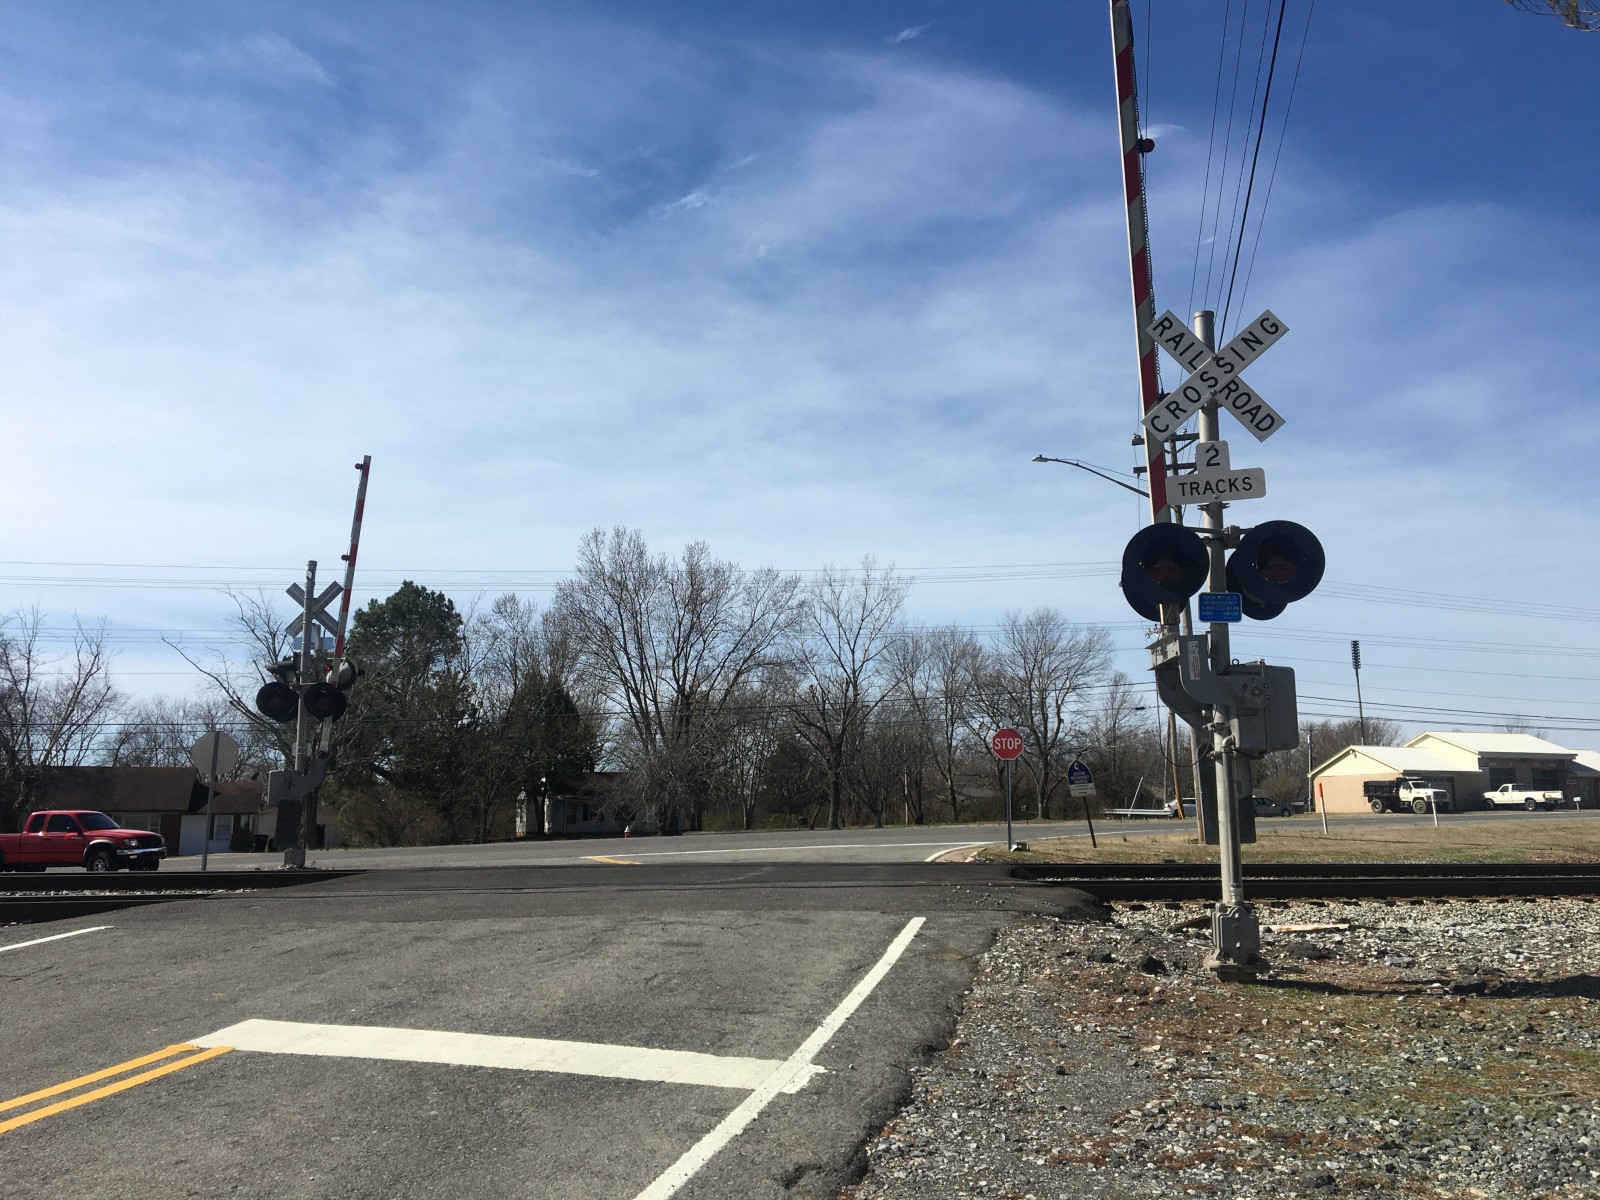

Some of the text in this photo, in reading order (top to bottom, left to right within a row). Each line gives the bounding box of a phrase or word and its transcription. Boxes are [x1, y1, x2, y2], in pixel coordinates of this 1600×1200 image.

[1150, 317, 1279, 433] CROSSING
[1152, 316, 1275, 432] RAIL ROAD
[1205, 447, 1221, 467] 2
[1178, 476, 1253, 497] TRACKS
[994, 738, 1022, 750] STOP
